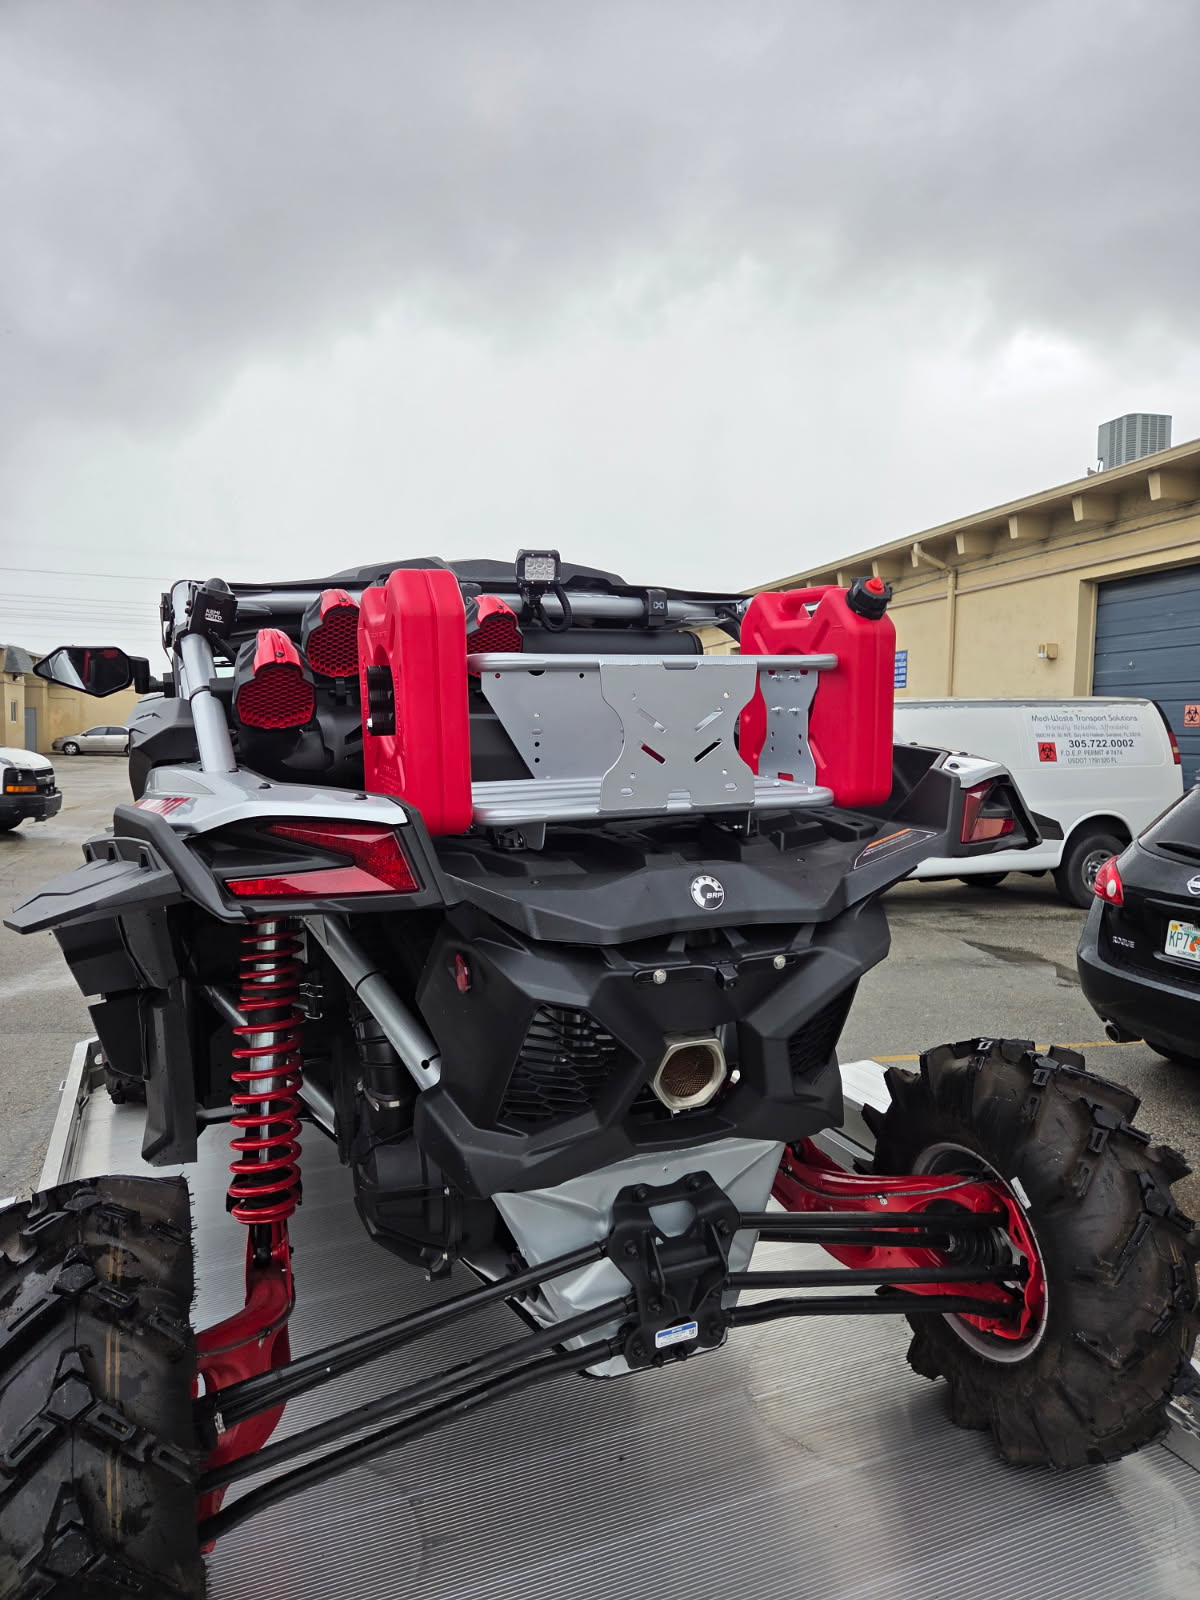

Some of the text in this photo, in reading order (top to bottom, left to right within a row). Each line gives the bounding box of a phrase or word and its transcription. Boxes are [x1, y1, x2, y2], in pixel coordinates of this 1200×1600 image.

[1075, 715, 1106, 723] Transport
[1107, 714, 1138, 722] Solutions
[1068, 739, 1134, 748] 305.722.0002
